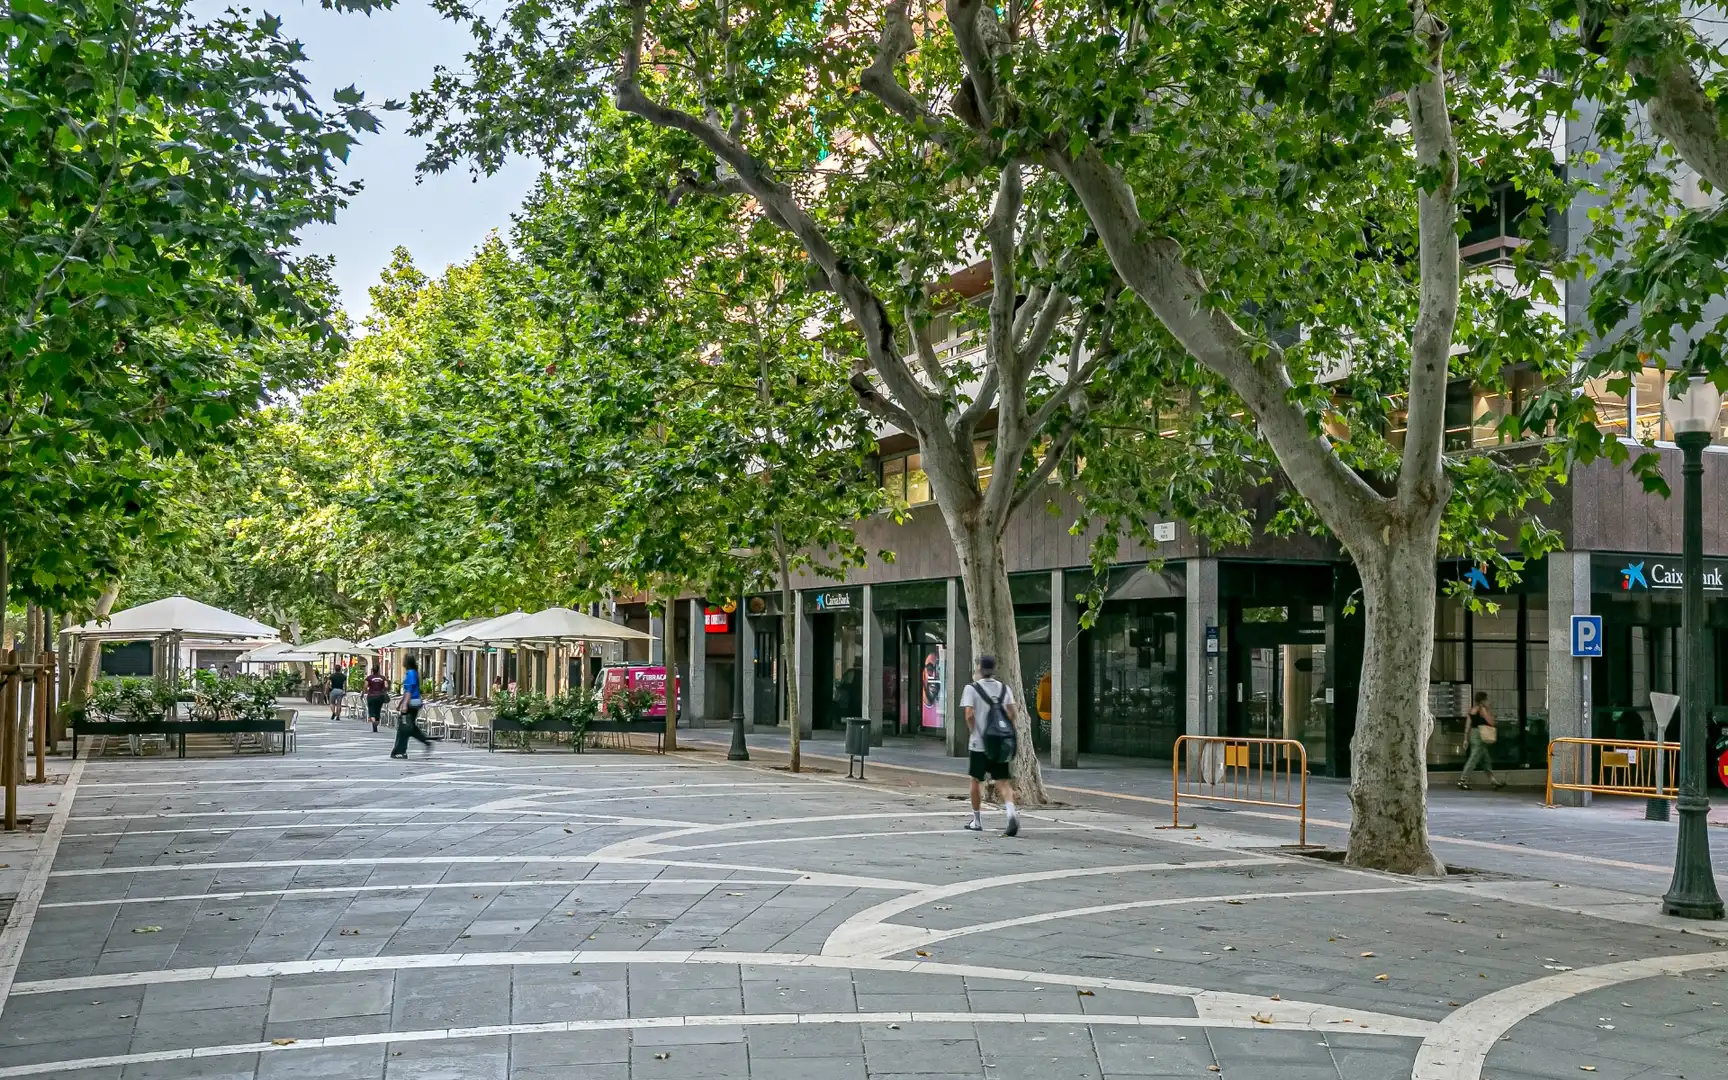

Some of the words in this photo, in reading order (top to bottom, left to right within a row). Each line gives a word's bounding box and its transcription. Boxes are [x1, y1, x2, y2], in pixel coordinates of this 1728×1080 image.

[1651, 563, 1723, 586] Caixank
[825, 593, 850, 606] CaixaBank
[1578, 620, 1597, 652] P
[642, 673, 667, 681] FIBRACA
